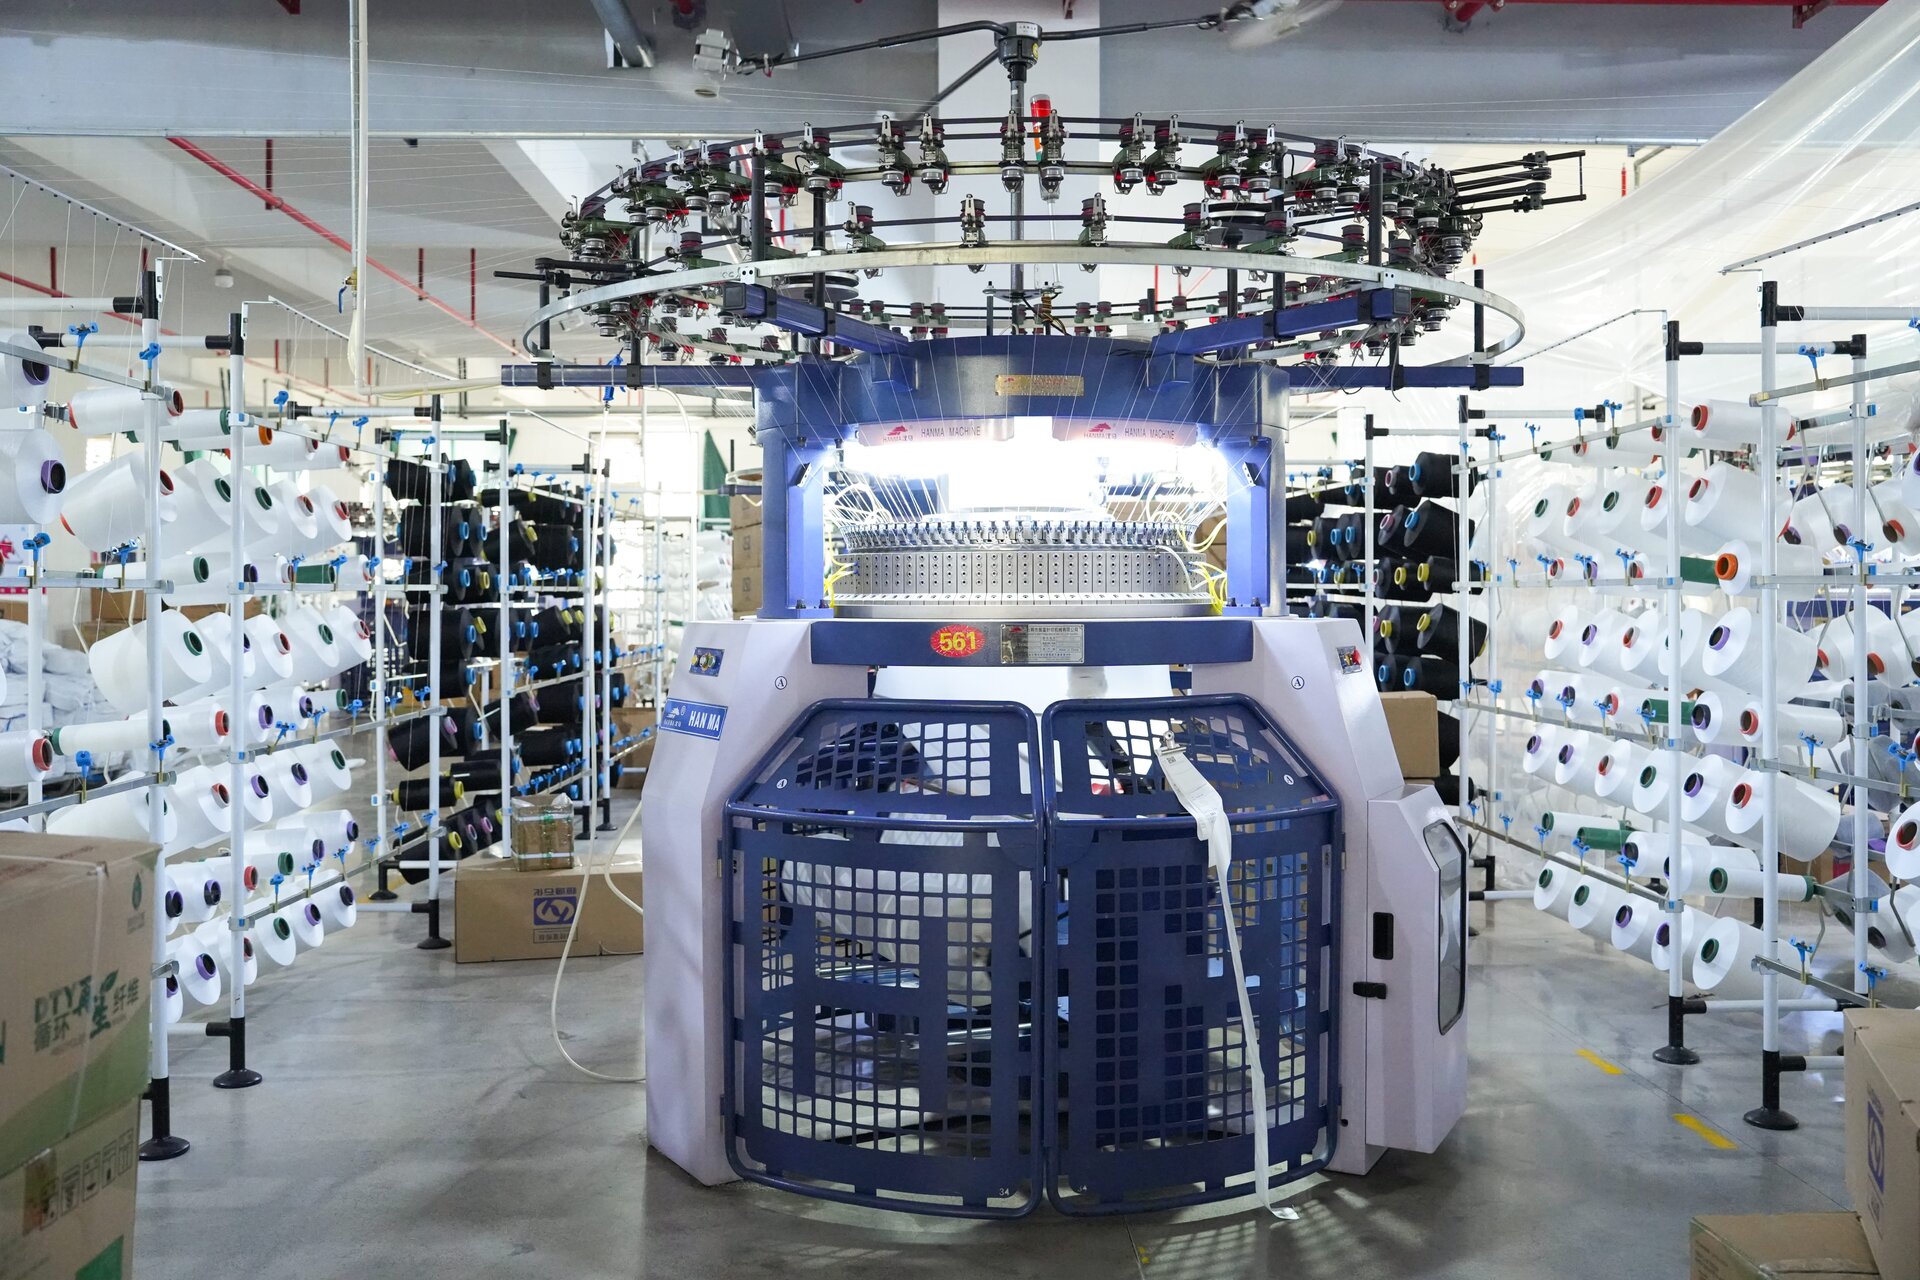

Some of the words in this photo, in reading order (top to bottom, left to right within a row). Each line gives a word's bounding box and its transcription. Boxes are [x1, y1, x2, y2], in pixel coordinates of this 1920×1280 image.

[921, 427, 944, 438] HANMA
[949, 425, 981, 437] MACHINE
[1124, 428, 1146, 438] HANMA
[1149, 429, 1175, 440] MACHINE
[939, 631, 976, 651] 561
[688, 710, 707, 729] HAN
[706, 713, 721, 731] MA
[34, 982, 76, 1023] DTY
[999, 1187, 1010, 1196] 34
